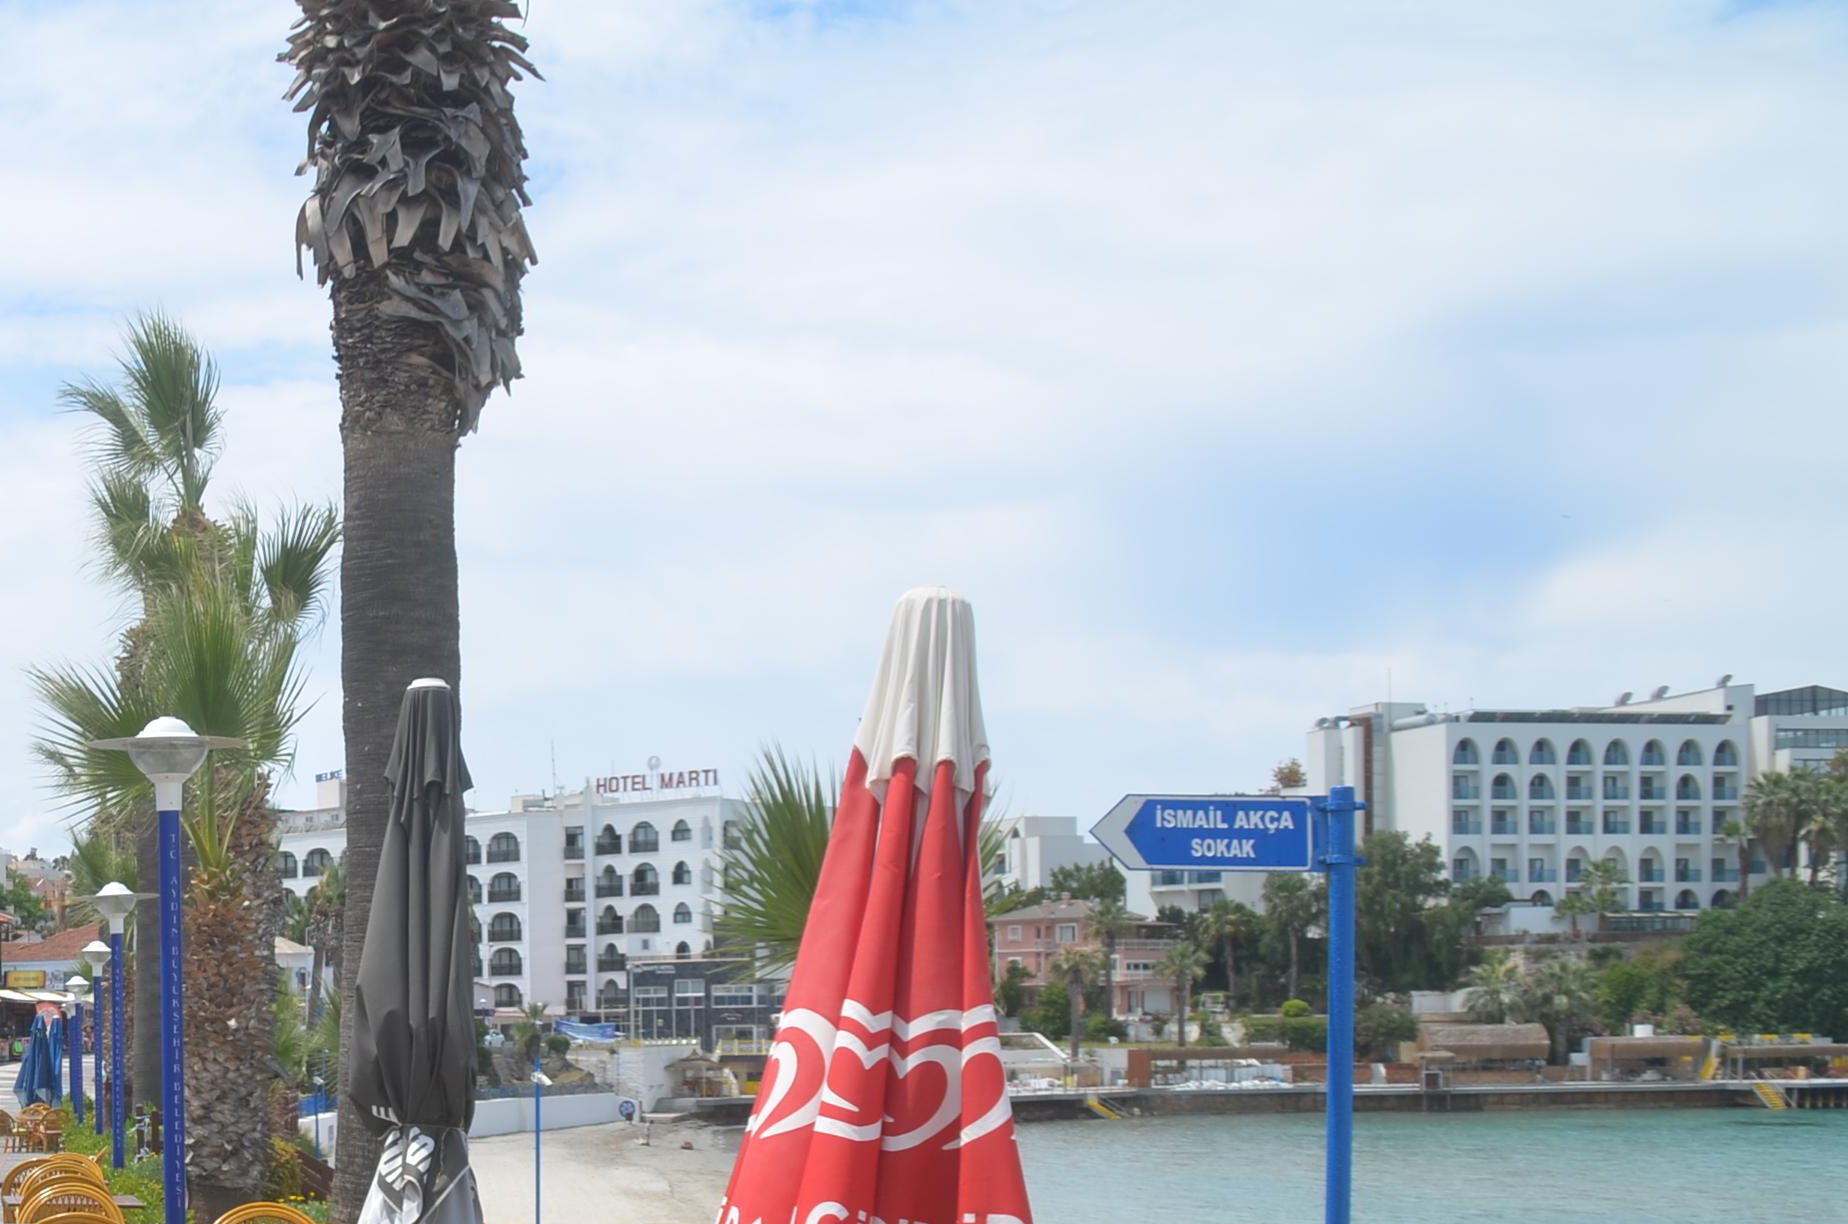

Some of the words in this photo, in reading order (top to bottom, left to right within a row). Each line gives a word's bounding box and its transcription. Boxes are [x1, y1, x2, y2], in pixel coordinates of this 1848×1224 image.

[595, 774, 653, 795] HOTEL
[659, 768, 719, 790] MARTI
[1155, 804, 1229, 829] İSMAİL
[1233, 809, 1295, 834] AKÇA
[1190, 838, 1256, 859] SOKAK
